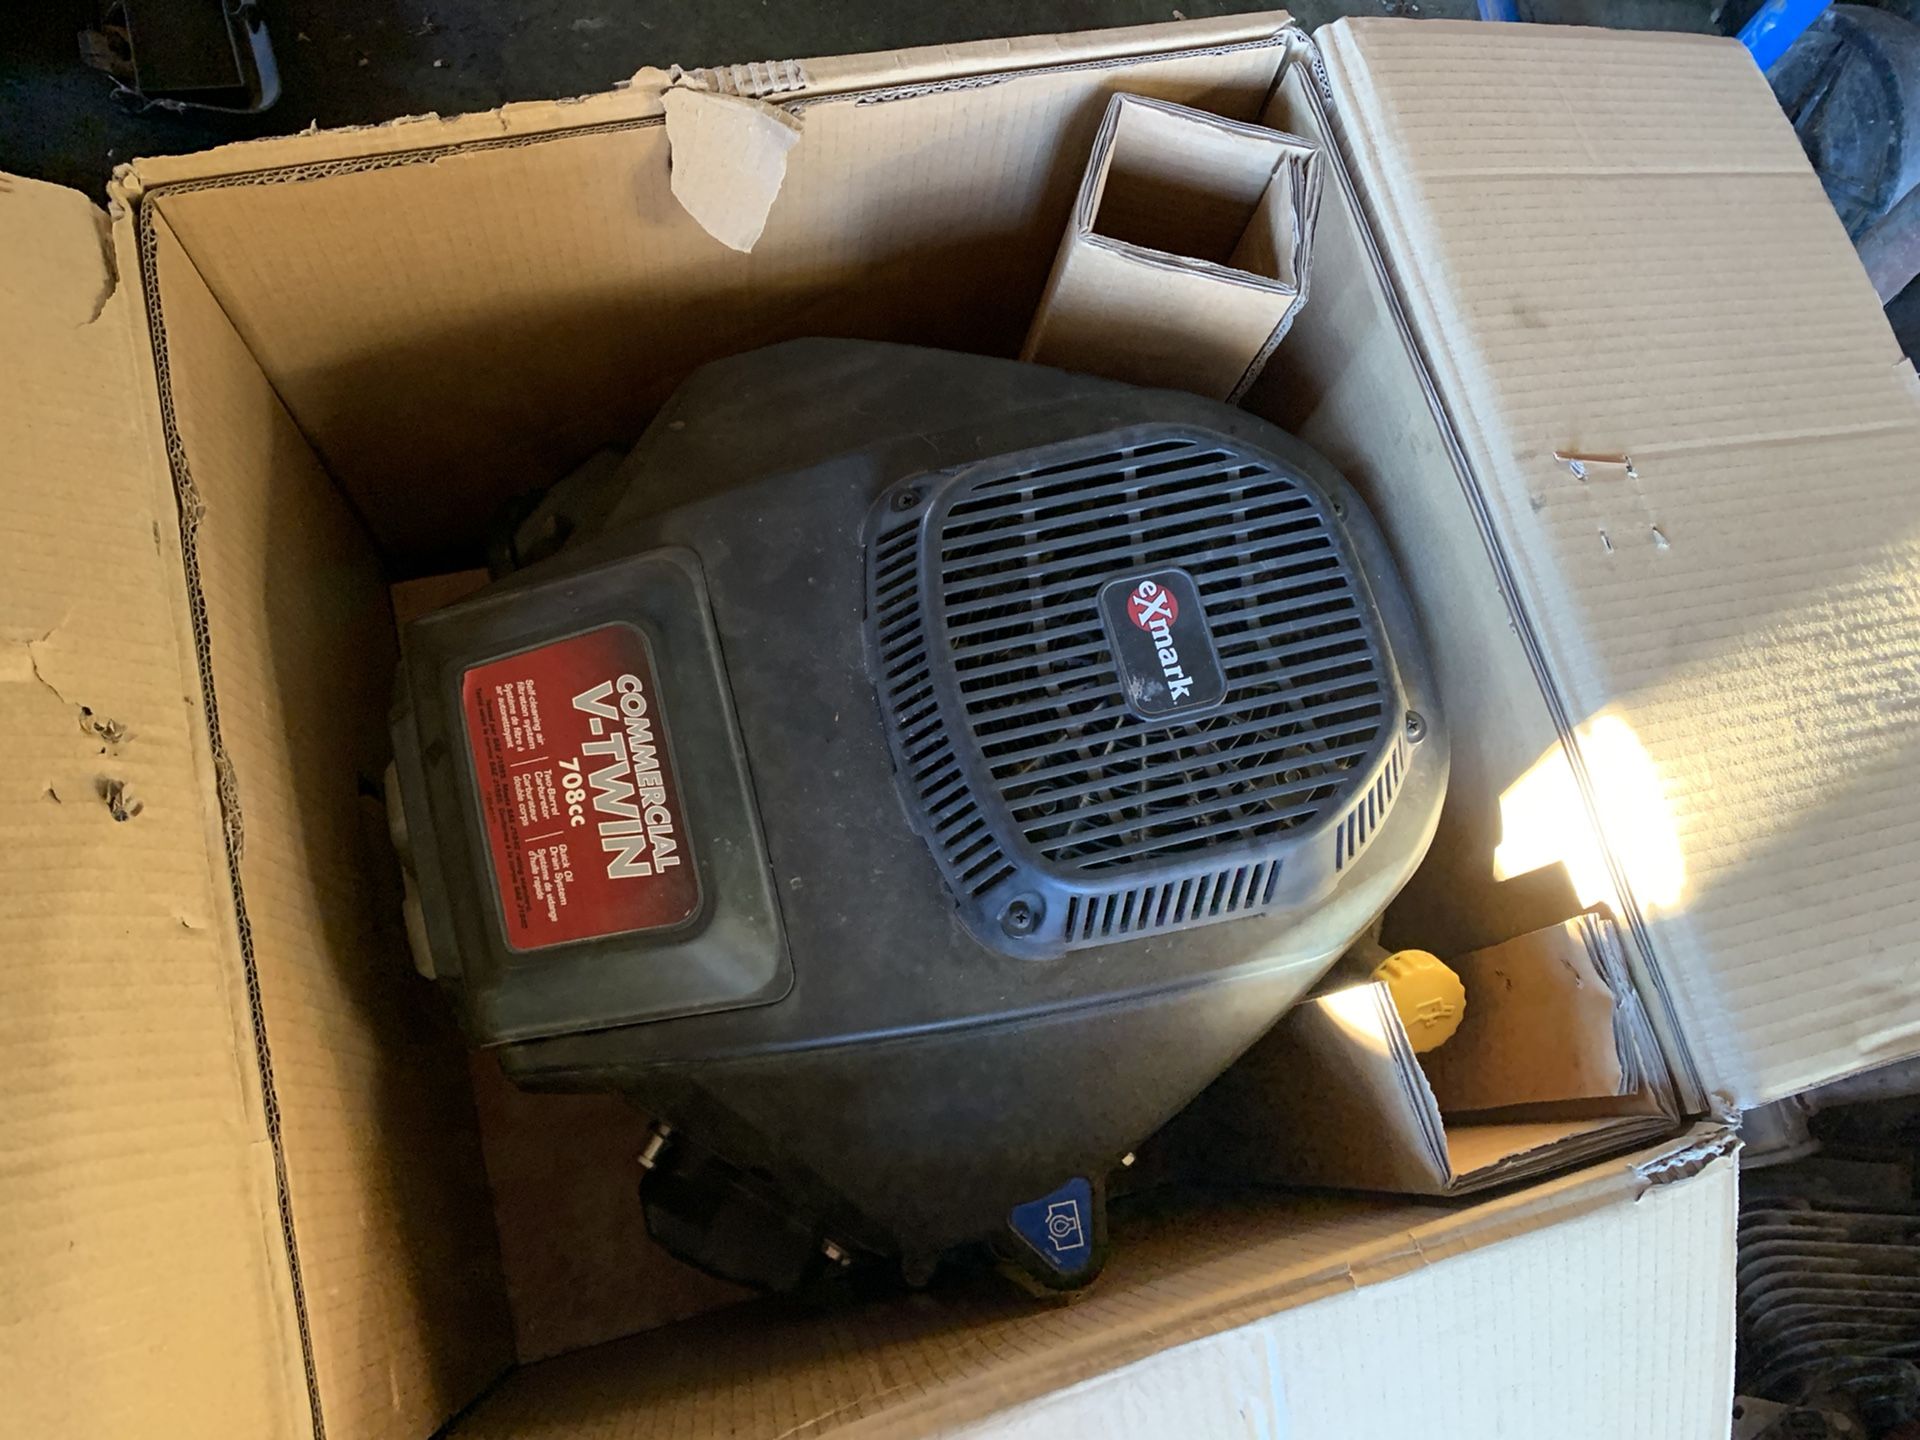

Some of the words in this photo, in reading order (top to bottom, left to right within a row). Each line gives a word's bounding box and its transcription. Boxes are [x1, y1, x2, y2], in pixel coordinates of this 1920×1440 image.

[1132, 580, 1194, 701] eXmark
[495, 685, 503, 696] air
[510, 715, 519, 725] de
[516, 681, 528, 717] filtration
[522, 719, 535, 749] system
[526, 679, 541, 731] Self-cleaning
[535, 733, 545, 745] air
[513, 726, 522, 745] filtre
[513, 775, 525, 801] double
[572, 680, 652, 878] V-TWIN
[616, 674, 680, 873] COMMERCIAL
[522, 773, 537, 822] Carburateur
[534, 771, 549, 819] Carburetor
[543, 769, 560, 815] Two-Barrel
[559, 757, 586, 827] 708cc
[518, 803, 529, 826] corps
[536, 848, 549, 880] Système
[549, 846, 560, 870] Drain
[558, 844, 570, 868] Quick
[533, 875, 544, 900] rapide
[543, 882, 553, 892] de
[554, 872, 567, 905] System
[563, 870, 573, 882] Oil
[546, 893, 557, 922] vidange
